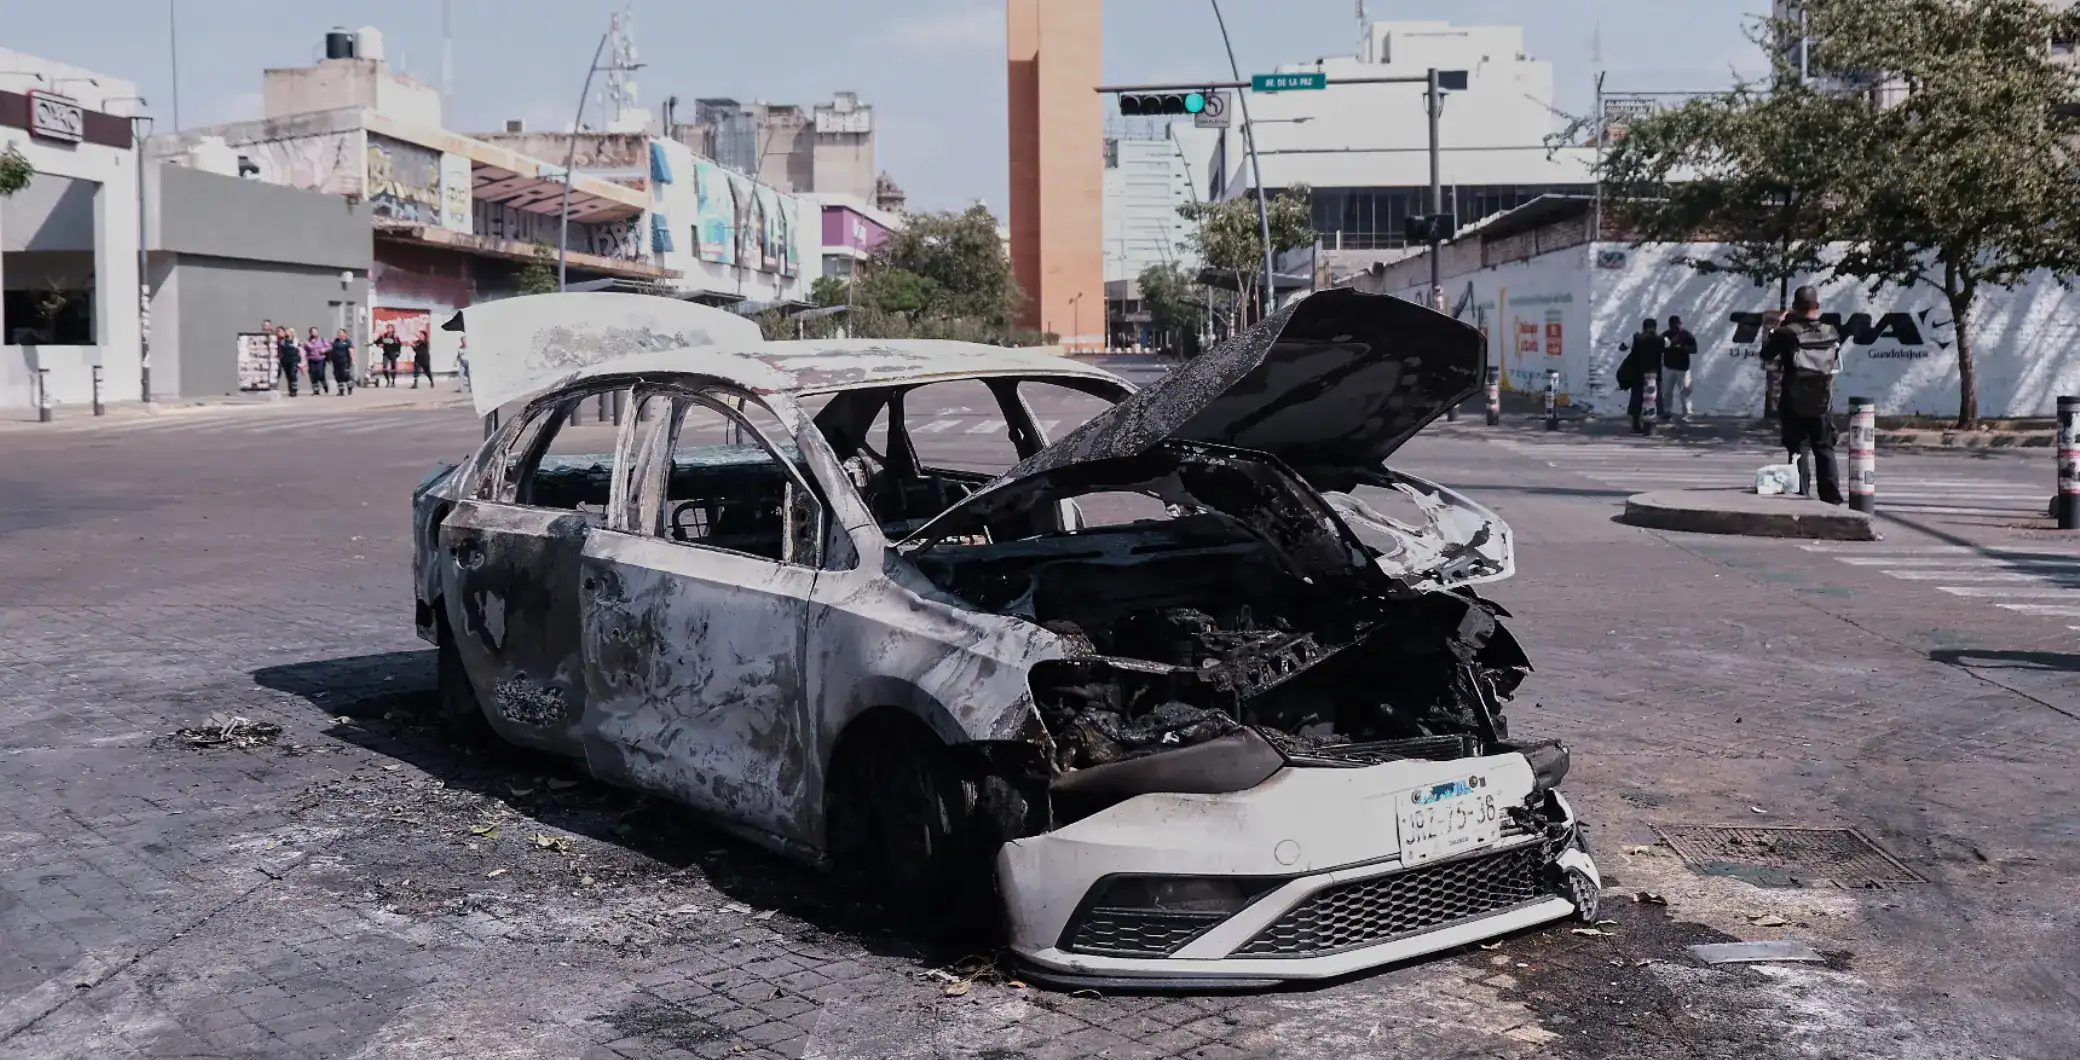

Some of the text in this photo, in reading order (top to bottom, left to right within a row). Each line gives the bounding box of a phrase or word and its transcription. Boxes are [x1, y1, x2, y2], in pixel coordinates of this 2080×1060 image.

[1277, 78, 1286, 87] DE
[1289, 78, 1298, 86] LA
[1300, 77, 1313, 86] PAZ
[1867, 349, 1929, 361] Guadalajara
